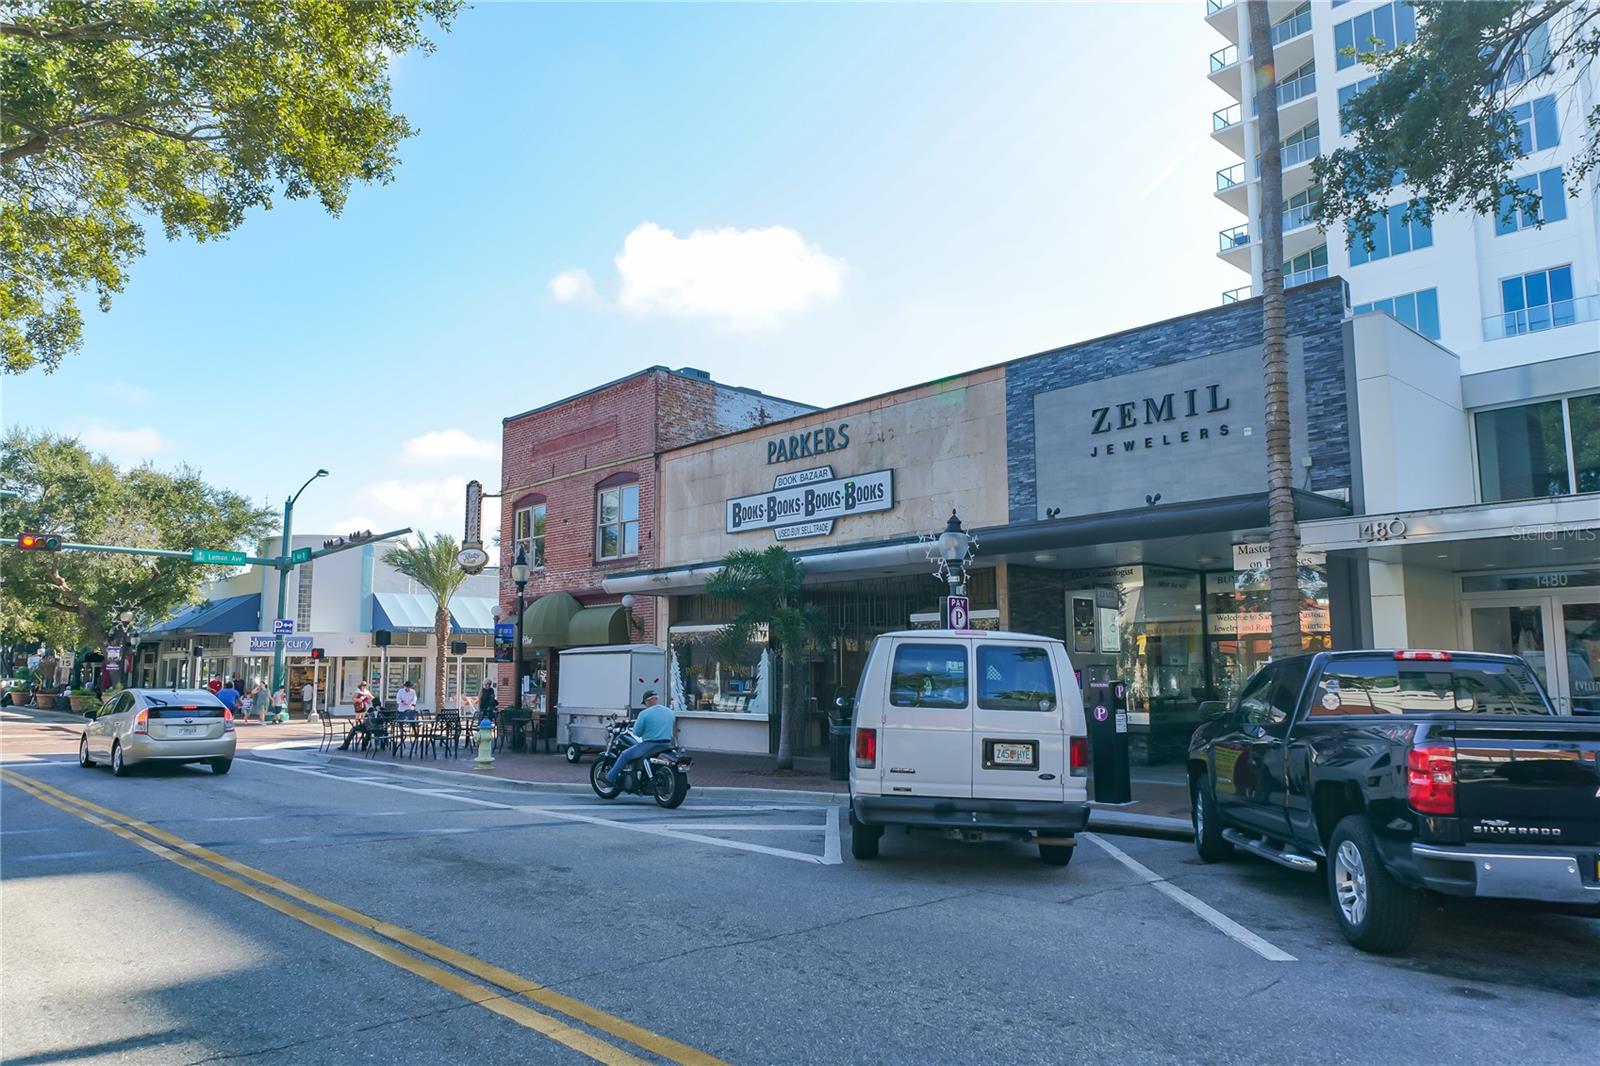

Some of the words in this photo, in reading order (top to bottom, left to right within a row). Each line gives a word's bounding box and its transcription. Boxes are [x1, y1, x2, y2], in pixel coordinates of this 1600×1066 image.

[1091, 384, 1230, 434] ZEMIL
[766, 423, 850, 465] PARKERS
[1090, 424, 1230, 458] JEWELERS
[778, 475, 797, 486] BOOK
[799, 469, 828, 482] BAZAAR
[1536, 573, 1568, 587] 1480
[951, 599, 965, 607] PAY
[955, 609, 963, 626] P
[249, 636, 312, 651] bluemcury
[1473, 826, 1561, 836] SILVERADO
